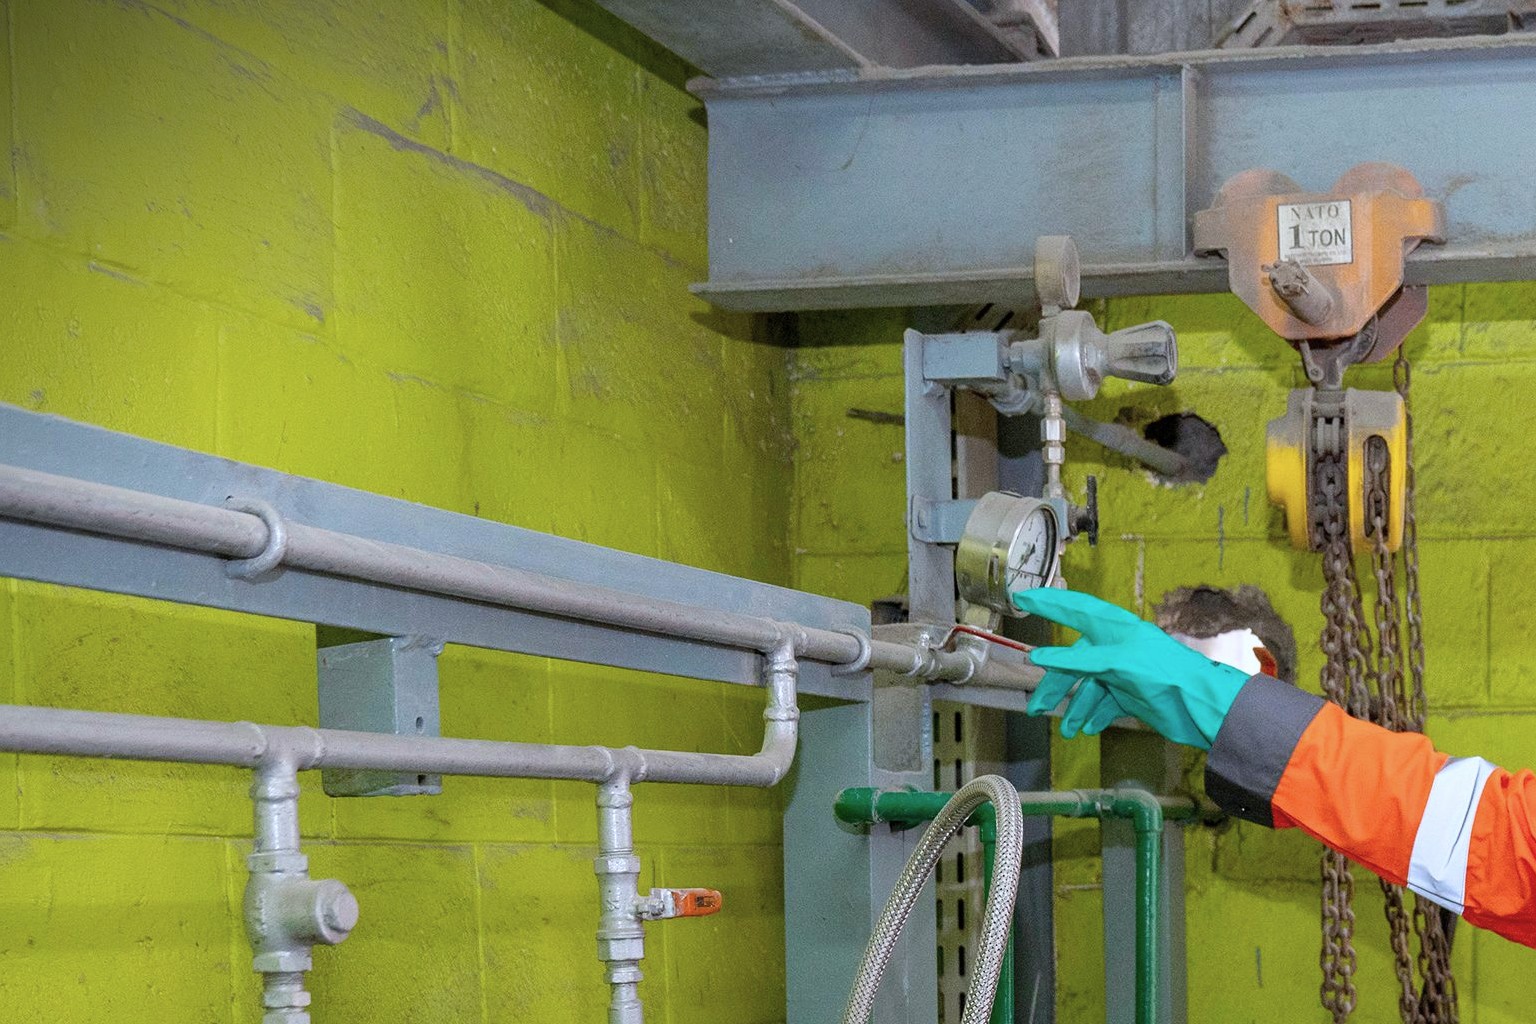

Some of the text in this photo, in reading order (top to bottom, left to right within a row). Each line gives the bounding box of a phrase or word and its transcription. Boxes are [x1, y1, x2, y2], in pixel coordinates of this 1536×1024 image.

[1290, 204, 1339, 220] NATO
[1289, 224, 1346, 250] 1 TON
